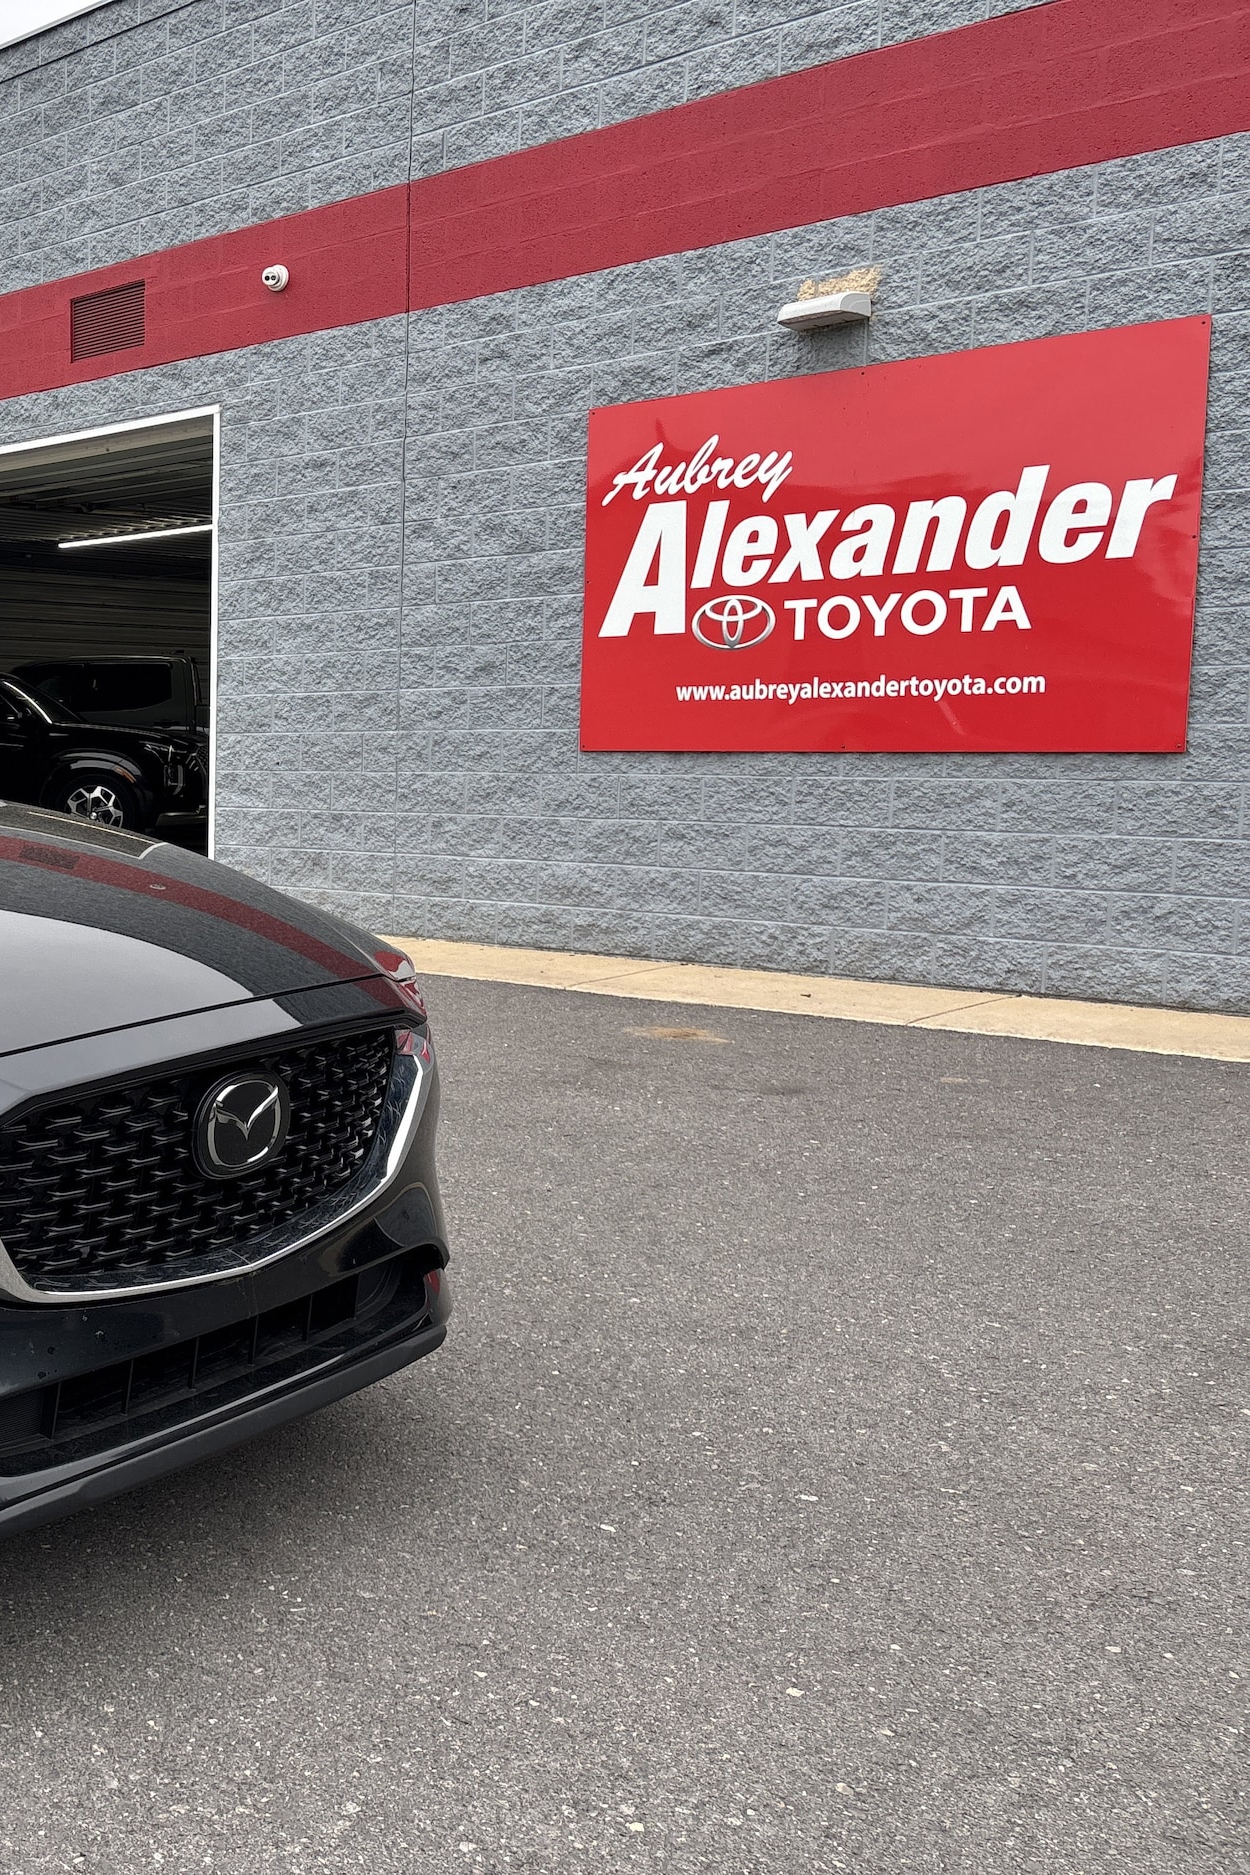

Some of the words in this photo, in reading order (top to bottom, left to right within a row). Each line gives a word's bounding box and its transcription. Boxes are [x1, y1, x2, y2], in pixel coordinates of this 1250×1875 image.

[601, 434, 793, 507] Aubrey
[597, 464, 1178, 638] Alexander
[783, 585, 1032, 641] TOYOTA
[676, 674, 1046, 705] www.aubreyalexandertoyota.com
